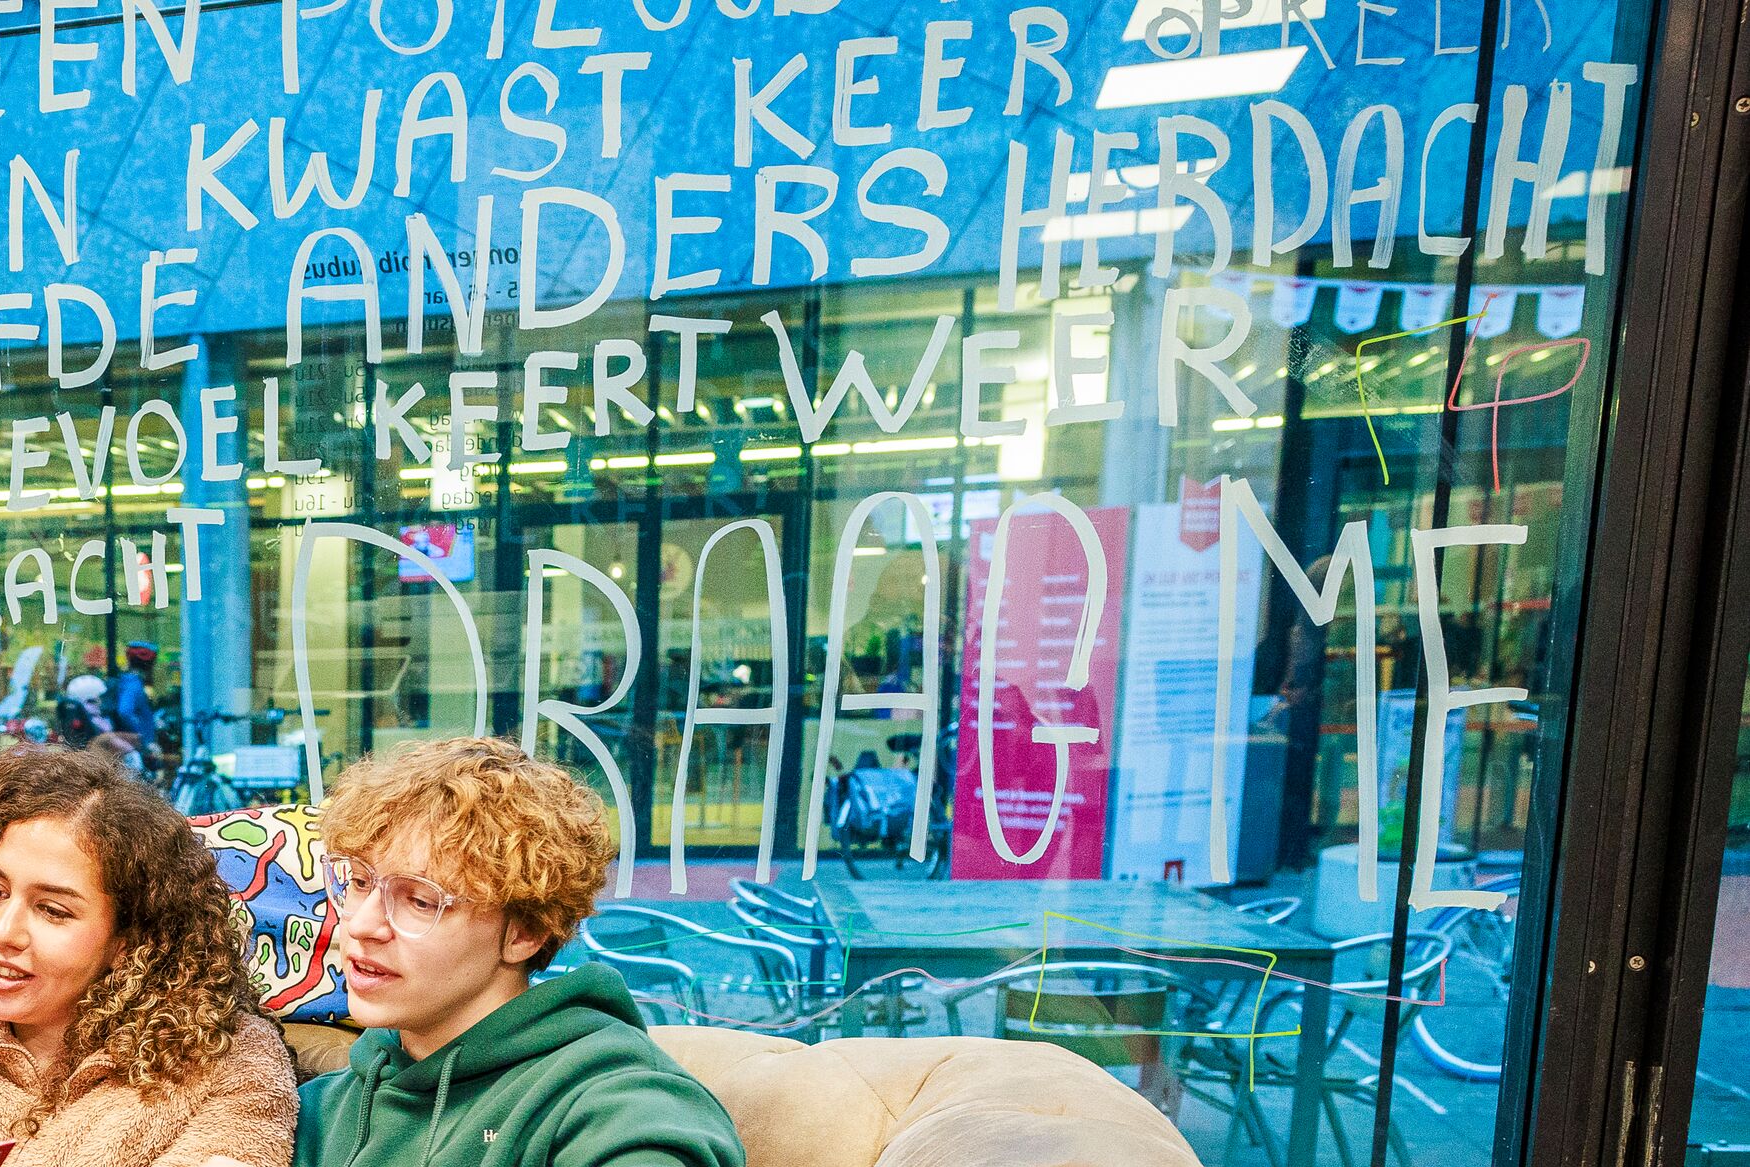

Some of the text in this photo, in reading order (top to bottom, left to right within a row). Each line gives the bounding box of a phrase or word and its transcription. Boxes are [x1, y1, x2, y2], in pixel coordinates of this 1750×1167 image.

[185, 50, 652, 232] KWAST
[732, 7, 1074, 168] KEER
[286, 147, 952, 367] ANDERS
[997, 61, 1639, 313] HERDACHT
[375, 313, 734, 471] KEERT
[759, 287, 1259, 443] WEER
[291, 490, 1110, 899] DRAAG
[1209, 473, 1529, 912] ME
